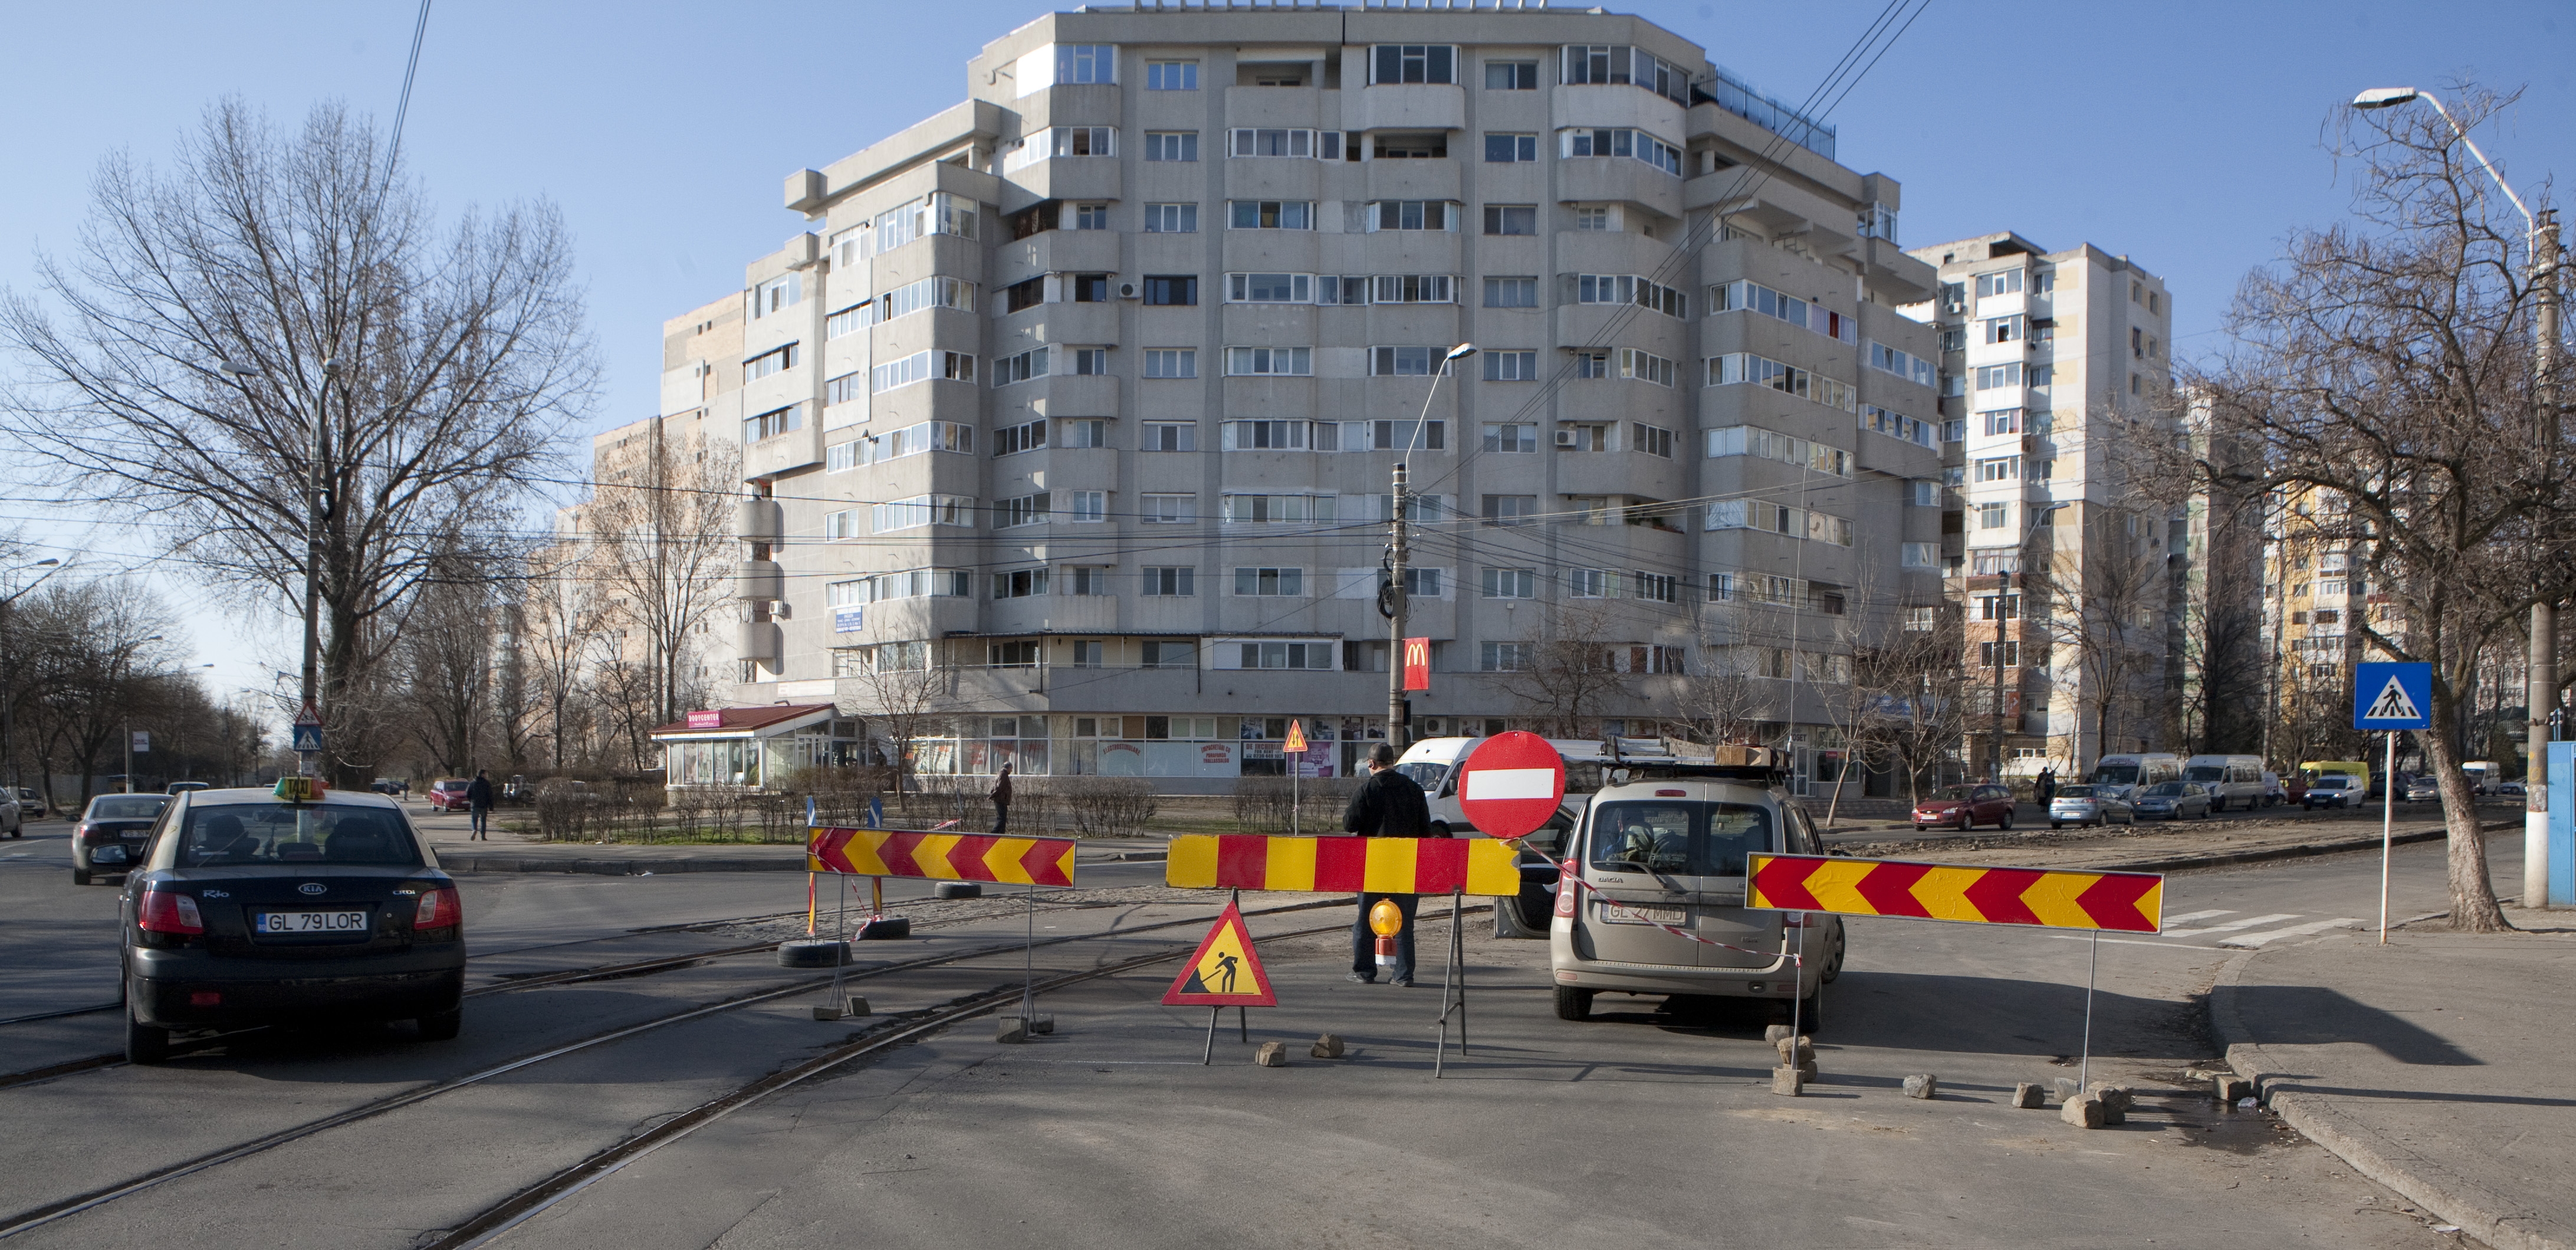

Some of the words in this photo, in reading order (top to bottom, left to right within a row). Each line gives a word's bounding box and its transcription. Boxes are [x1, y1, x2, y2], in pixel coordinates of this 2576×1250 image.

[689, 713, 719, 721] BODYCENTER
[1103, 744, 1141, 756] ELECTROSTIMULARE
[288, 779, 308, 793] TAXI
[203, 890, 229, 898] Rio
[1611, 905, 1628, 918] GL
[1634, 905, 1651, 920] 27
[1652, 905, 1683, 920] MMD
[270, 915, 293, 930] GL
[301, 914, 323, 930] 79
[326, 913, 362, 929] LOR
